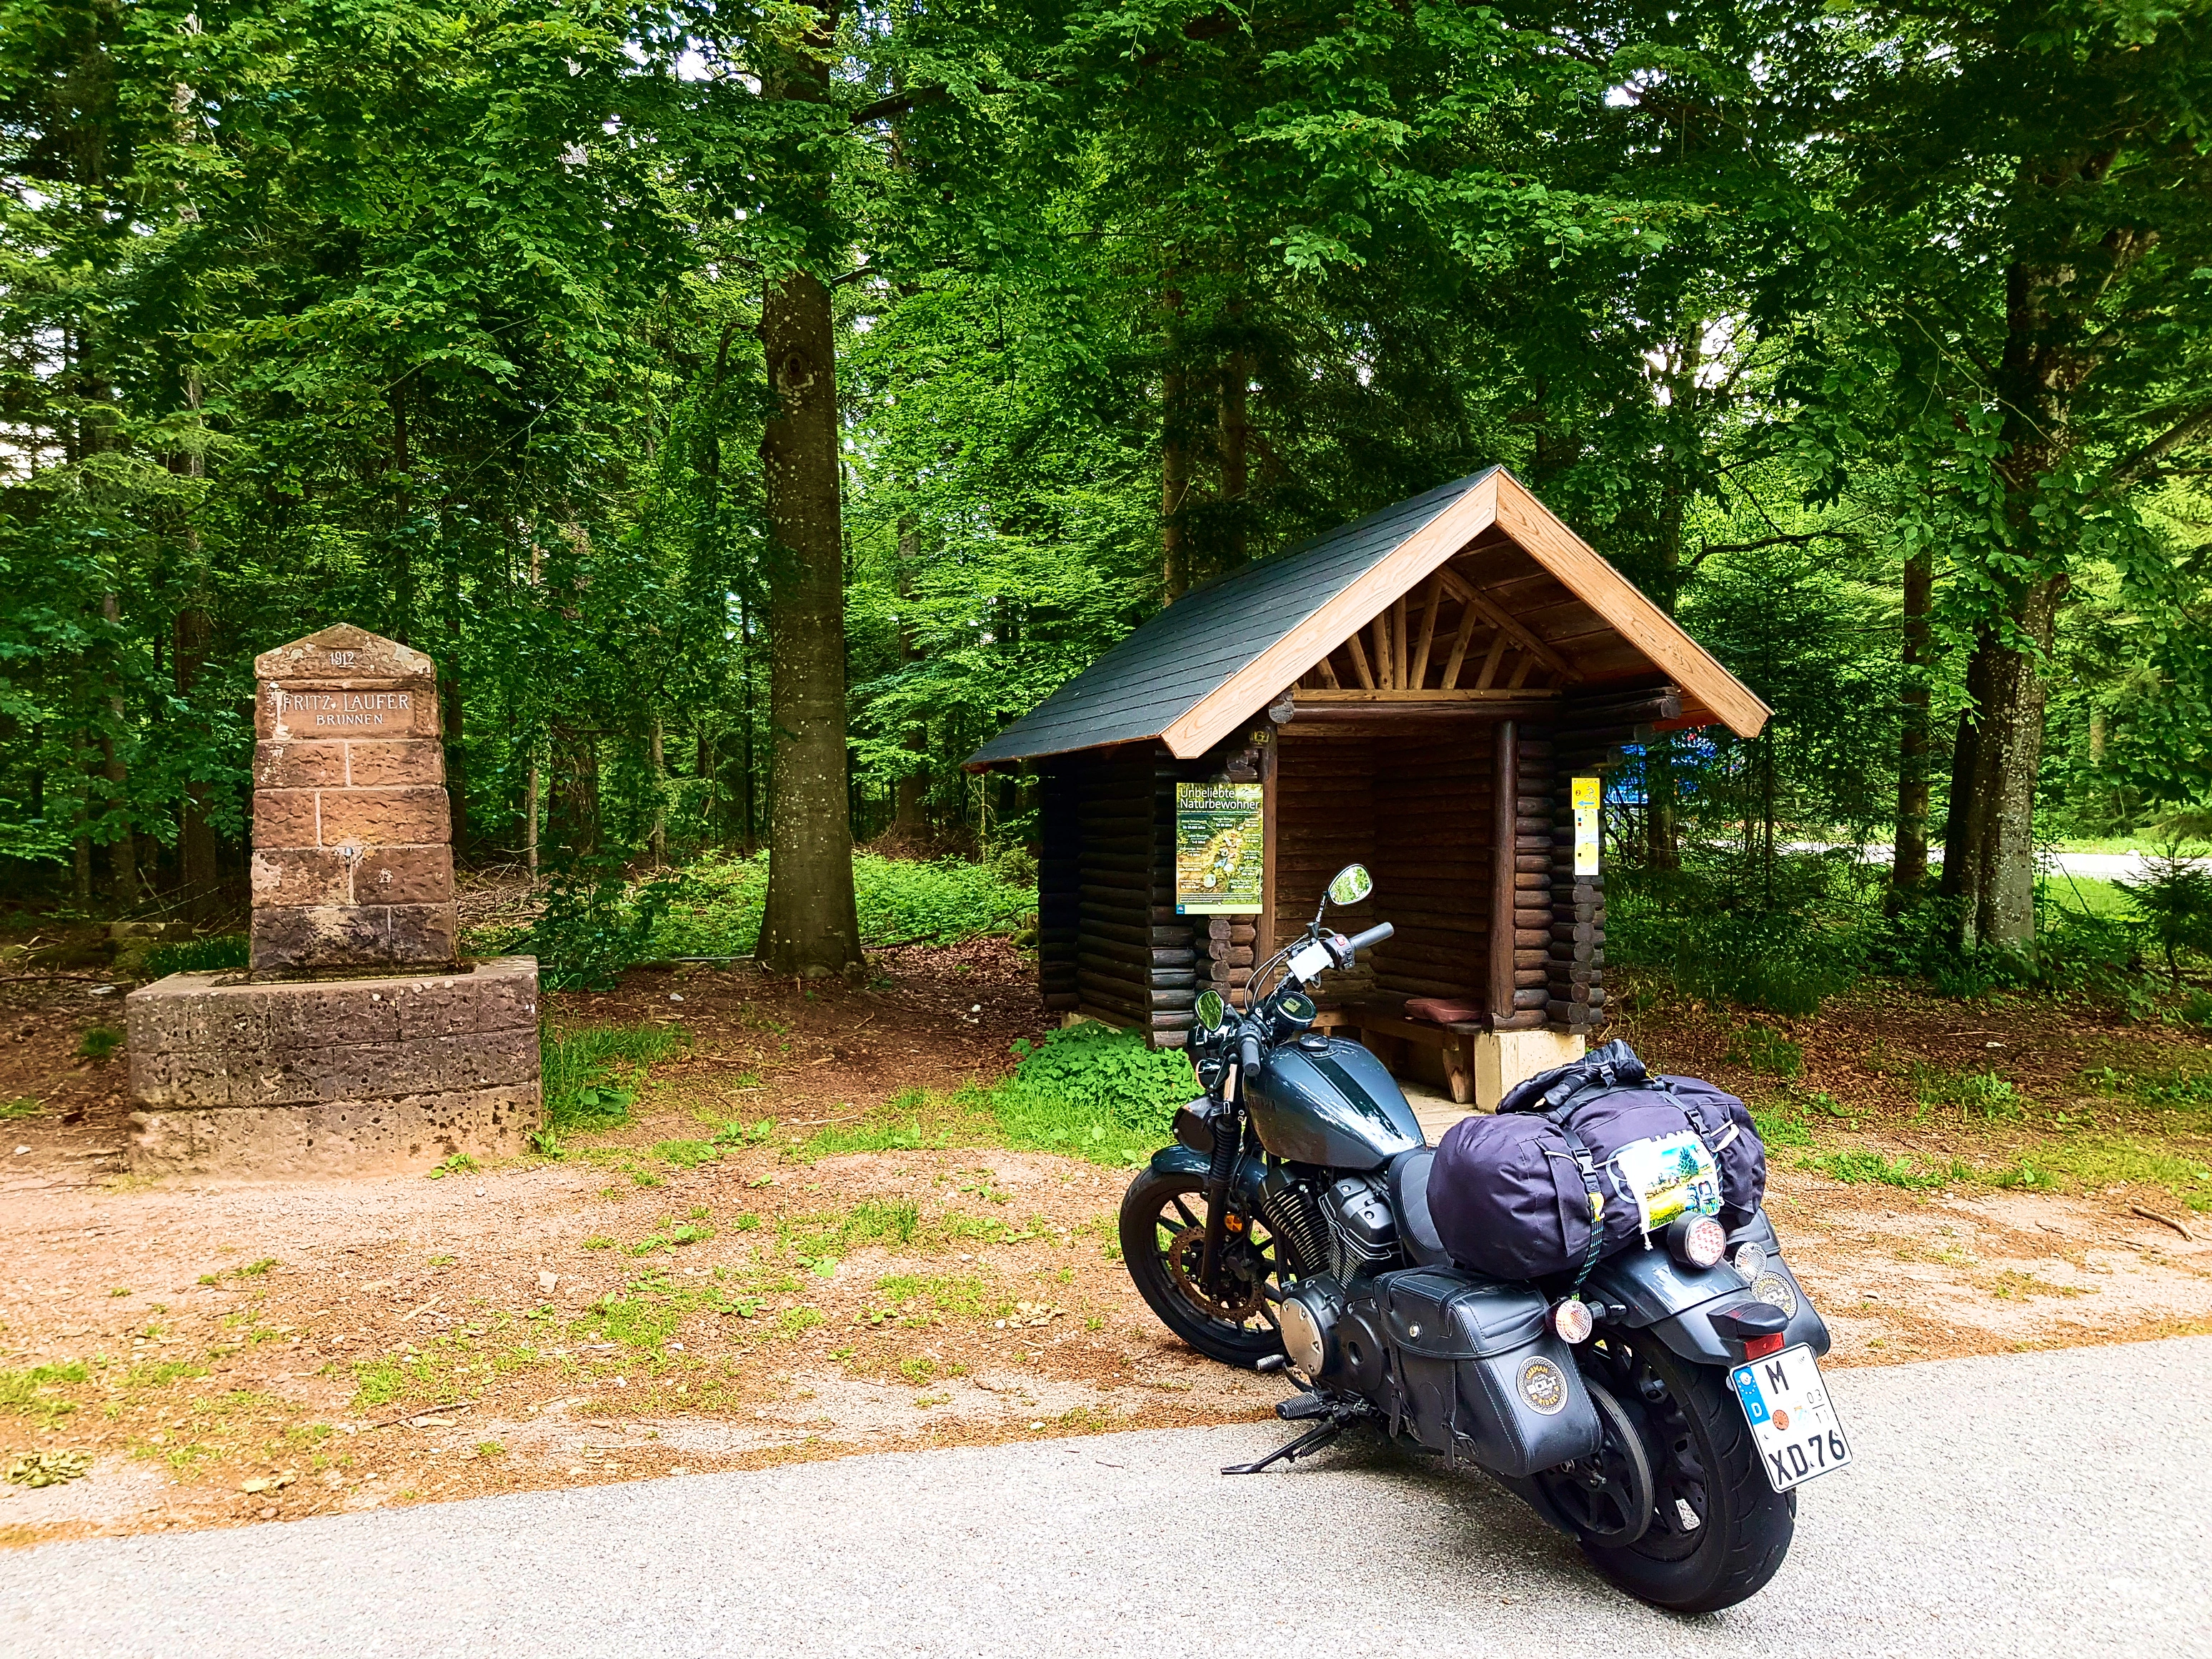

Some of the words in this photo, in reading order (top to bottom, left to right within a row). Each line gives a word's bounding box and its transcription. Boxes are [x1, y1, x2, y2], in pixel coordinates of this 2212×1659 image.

[329, 651, 354, 665] 1912
[343, 694, 409, 713] LAUFER
[317, 714, 384, 726] BRUNNEN
[1180, 787, 1235, 799] Unbeliebte
[1180, 798, 1260, 809] Naturbewohner
[1758, 1279, 1778, 1292] GERMAN
[1525, 1365, 1549, 1380] GERMAN
[1765, 1360, 1789, 1394] M
[1526, 1375, 1557, 1395] BOLT
[1538, 1394, 1559, 1406] RIDERS
[1751, 1402, 1763, 1418] D
